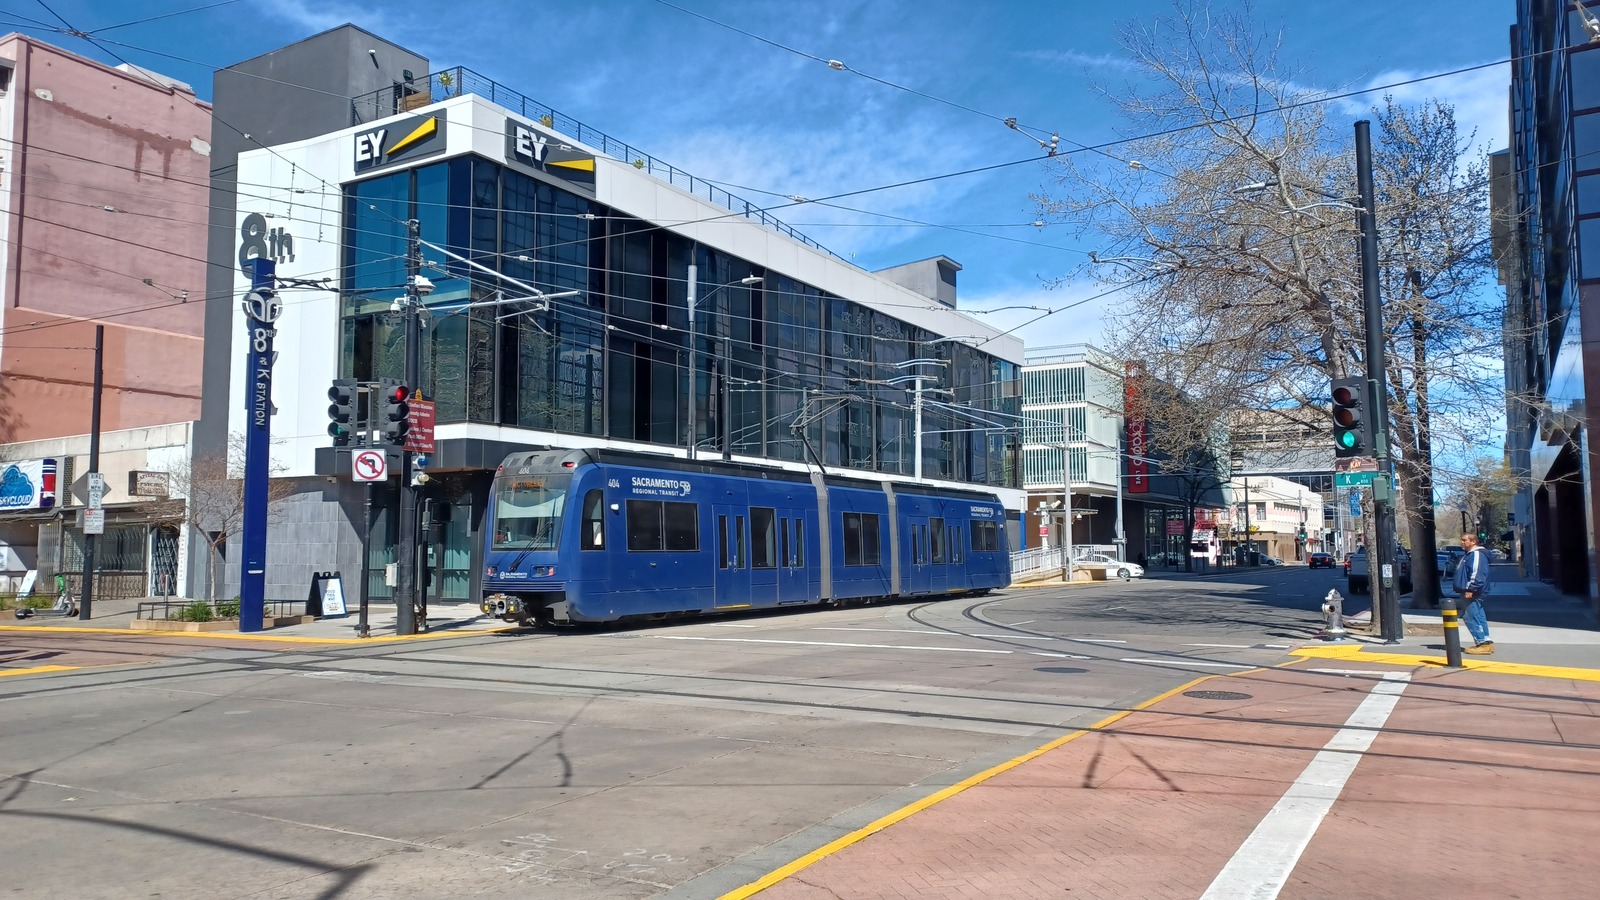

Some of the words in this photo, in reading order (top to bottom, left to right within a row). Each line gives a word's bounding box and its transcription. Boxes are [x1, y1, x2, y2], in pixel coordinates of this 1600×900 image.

[356, 129, 386, 162] EY
[516, 126, 547, 161] EY
[257, 369, 270, 379] K
[255, 383, 266, 426] STATION
[1350, 461, 1361, 469] KAY
[608, 479, 620, 488] 404
[632, 477, 678, 489] SACRAMENTO
[1346, 475, 1351, 484] K
